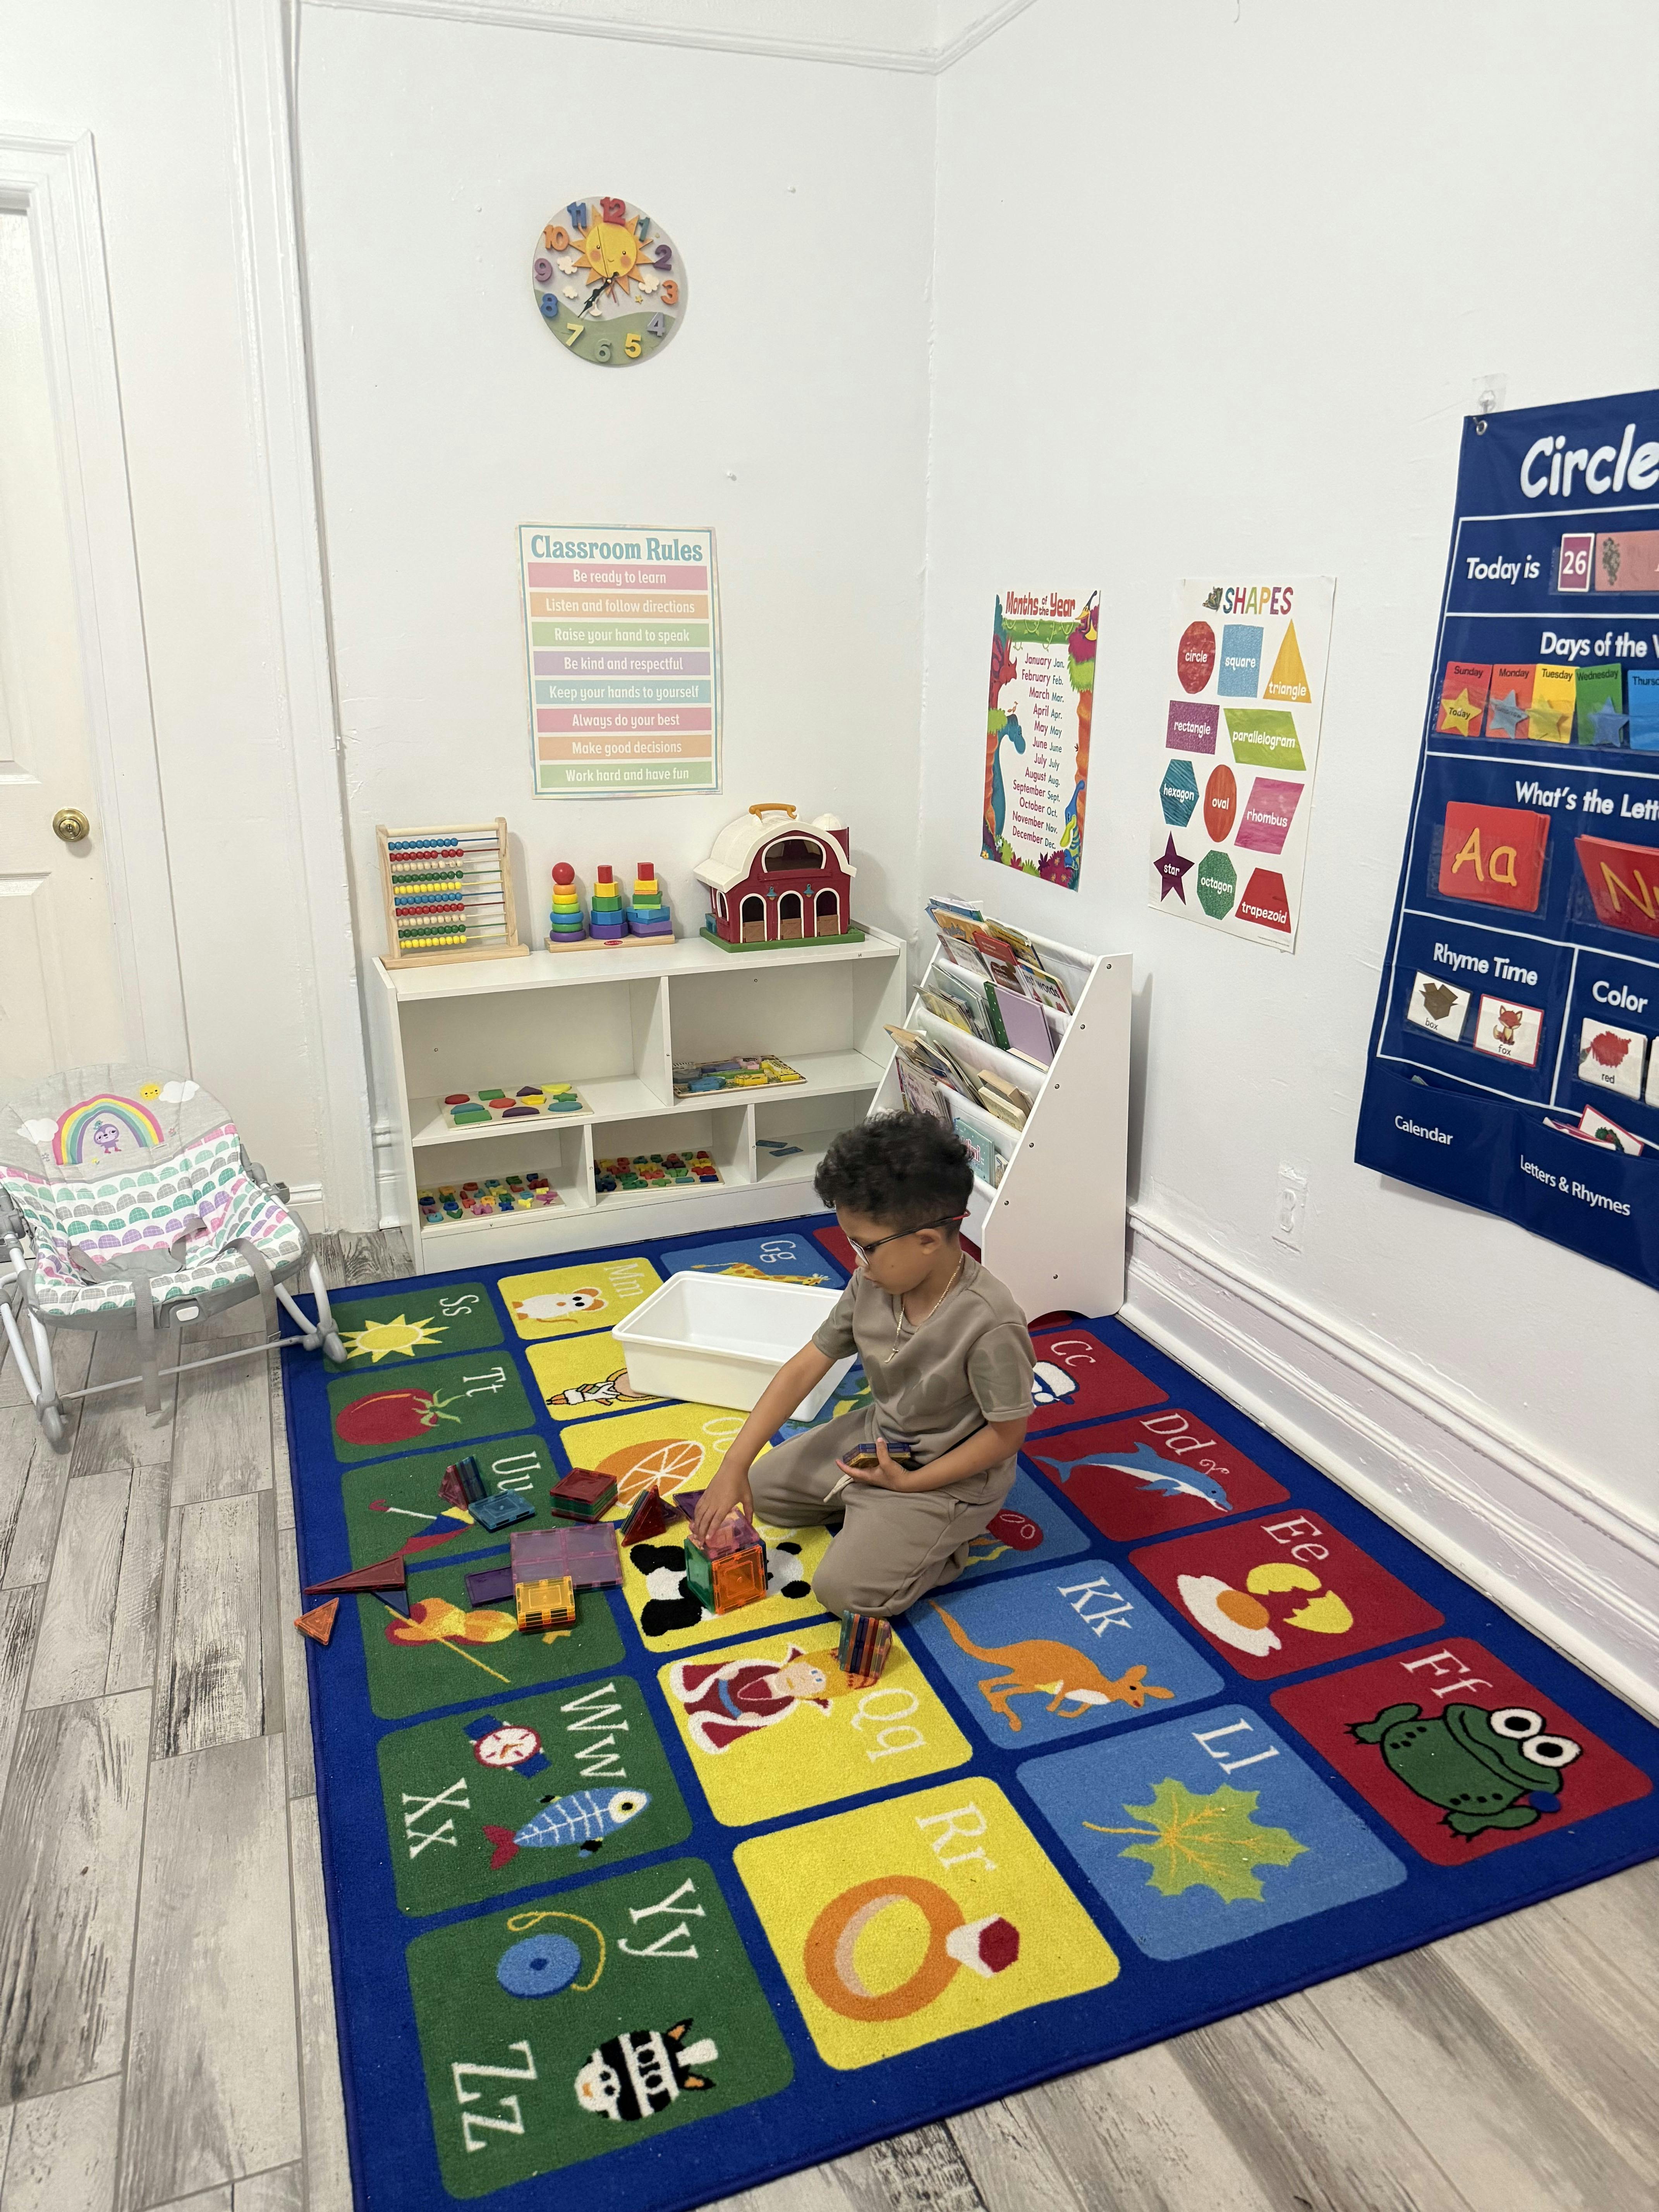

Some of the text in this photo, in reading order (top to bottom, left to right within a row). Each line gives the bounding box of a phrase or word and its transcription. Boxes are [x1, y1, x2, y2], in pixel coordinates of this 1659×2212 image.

[567, 202, 587, 229] 11
[600, 197, 626, 225] 12
[543, 224, 570, 251] 10
[639, 217, 650, 242] 1
[653, 244, 672, 271] 2
[534, 258, 553, 282] 9
[661, 280, 678, 305] 3
[540, 293, 558, 318] 8
[567, 323, 584, 347] 7
[647, 312, 665, 337] 4
[594, 338, 612, 362] 6
[624, 333, 641, 358] 5
[1520, 423, 1659, 498] Circle
[531, 534, 703, 562] Classroom Rules
[573, 569, 666, 586] Be ready to learn
[1467, 551, 1587, 585] Today is 26
[546, 598, 695, 613] Listen and follow directions
[1005, 591, 1075, 617] Months of the Year
[1223, 587, 1293, 615] SHAPES
[555, 627, 690, 644] Raise your hand to speak
[1540, 632, 1590, 661] Days
[1594, 632, 1613, 657] of
[1615, 632, 1647, 658] the
[564, 656, 683, 672] Be kind and respectful
[1025, 653, 1065, 669] January Jan.
[1185, 650, 1207, 663] circle
[1225, 656, 1256, 671] square
[1022, 669, 1063, 686] February Feb.
[1454, 666, 1484, 678] Sunday
[1499, 668, 1530, 678] Monday
[1542, 669, 1573, 682] Tuesday
[1577, 670, 1618, 681] Wednesday
[550, 685, 699, 701] Keep your hands to yourself
[1029, 687, 1064, 703] March Mar.
[1269, 681, 1306, 701] triangle
[572, 713, 680, 728] Always do your best
[1033, 703, 1062, 721] April Apr.
[1449, 707, 1470, 720] Today
[1034, 720, 1062, 738] May May
[1174, 720, 1211, 738] rectangle
[1232, 730, 1295, 750] parallelogram
[572, 740, 682, 756] Make good decisions
[1032, 737, 1062, 753] June June
[1034, 753, 1060, 771] July July
[566, 768, 689, 782] Work hard and have fun
[1025, 767, 1060, 787] August Aug.
[1013, 779, 1060, 804] September Sept.
[1163, 783, 1194, 802] hexagon
[1516, 781, 1659, 821] What's the Lett
[1019, 797, 1057, 817] October Oct.
[1212, 797, 1229, 810] oval
[1013, 811, 1058, 834] November Nov.
[1247, 811, 1288, 828] rhombus
[1013, 826, 1056, 849] December Dec.
[1451, 828, 1517, 887] Aa
[1164, 863, 1180, 876] star
[1200, 876, 1233, 895] octagon
[1600, 861, 1659, 920] N
[1242, 901, 1287, 924] trapezoid
[1433, 942, 1538, 986] Rhyme Time
[1035, 980, 1060, 999] words
[1592, 980, 1648, 1014] Color
[1425, 1018, 1439, 1030] box
[1498, 1044, 1511, 1056] fox
[1601, 1073, 1615, 1084] red
[1395, 1115, 1453, 1146] Calendar
[1520, 1155, 1630, 1216] Letters & Rhymes
[760, 1240, 796, 1263] Gg
[604, 1263, 645, 1298] Mm
[439, 1294, 479, 1317] Ss
[1050, 1340, 1096, 1367] Cc
[463, 1367, 507, 1398] Tt
[1139, 1413, 1217, 1456] Dd
[1260, 1516, 1329, 1562] Ee
[1057, 1577, 1134, 1637] Kk
[1400, 1649, 1493, 1699] Ff
[560, 1682, 629, 1779] Ww
[850, 1688, 927, 1764] Qq
[402, 1777, 470, 1859] Xx
[915, 1801, 997, 1871] Rr
[618, 1877, 706, 1959] Yy
[452, 2040, 537, 2153] Zz
